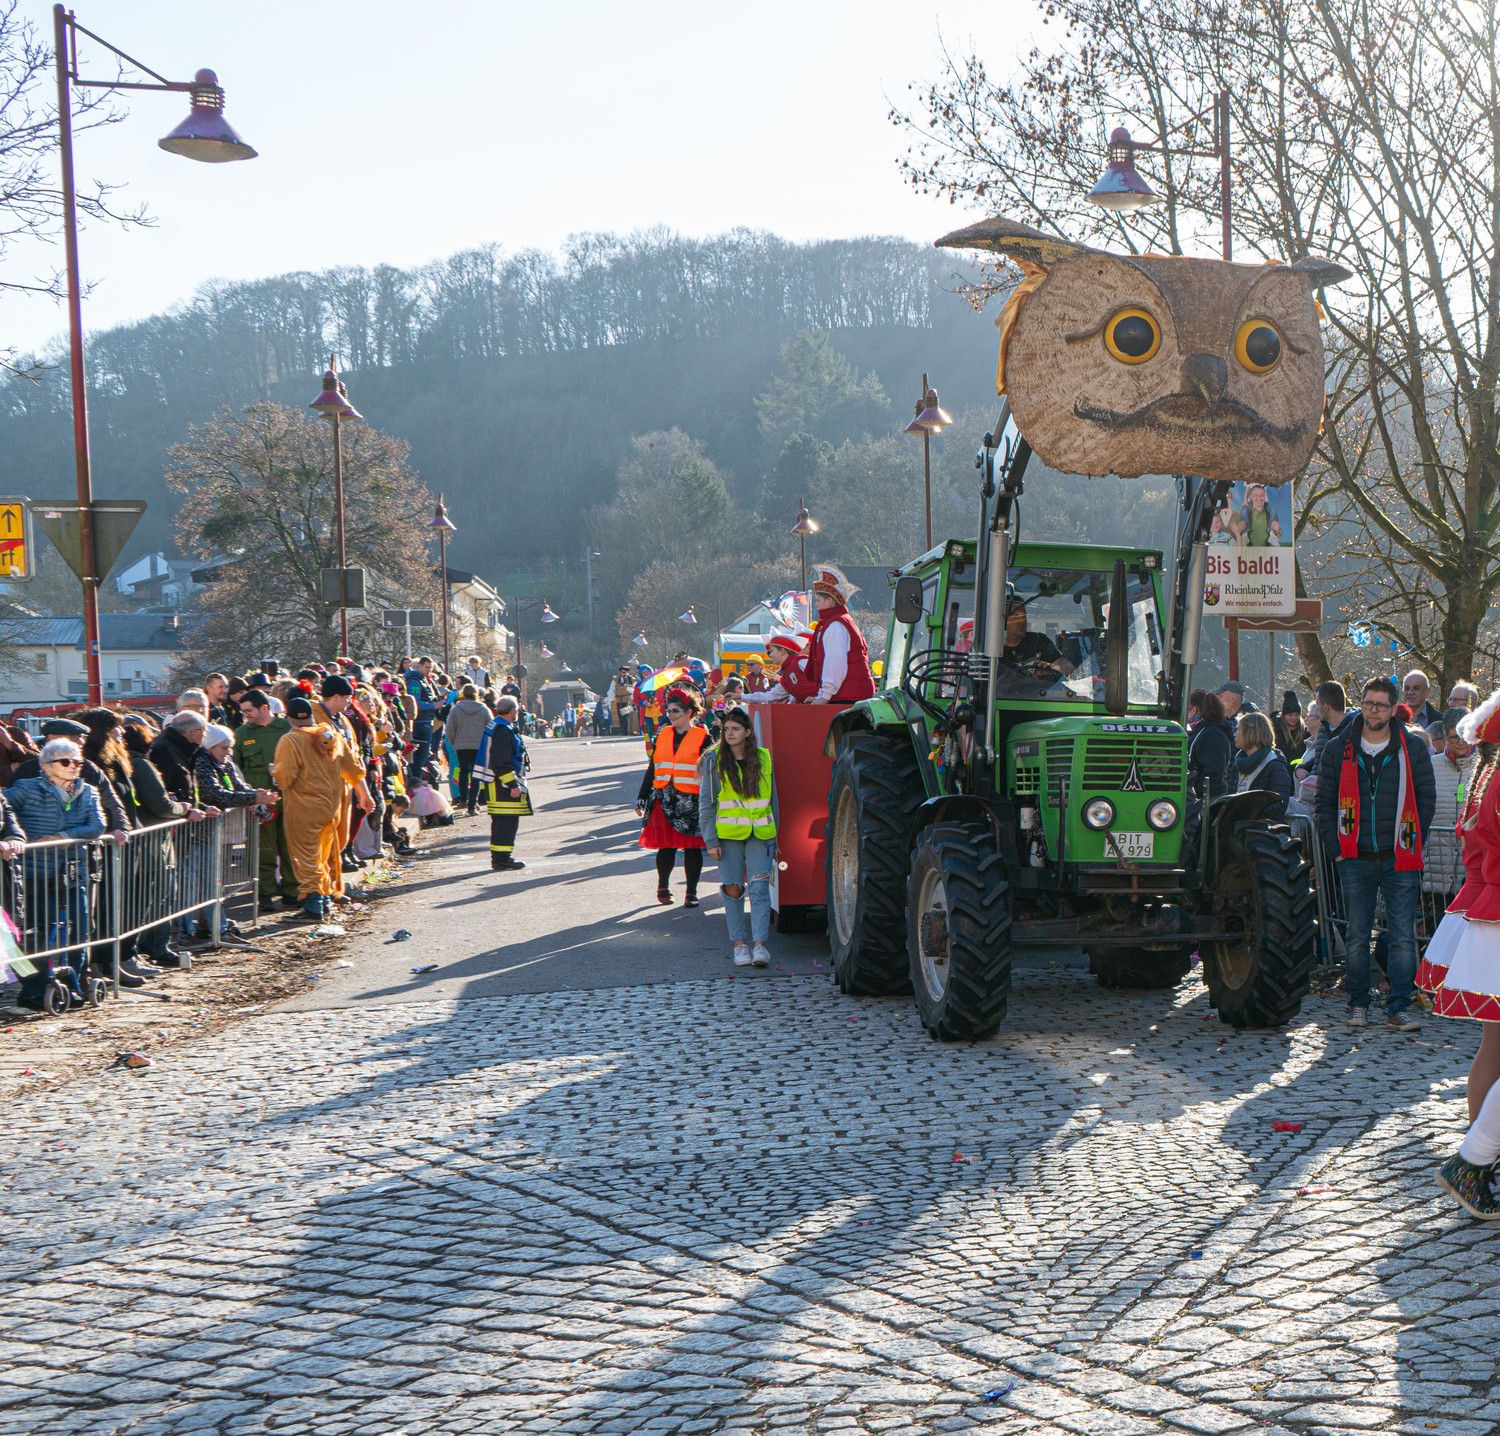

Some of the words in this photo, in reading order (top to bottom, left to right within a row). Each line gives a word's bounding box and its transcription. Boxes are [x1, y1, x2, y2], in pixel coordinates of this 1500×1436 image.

[1206, 555, 1231, 575] Bis
[1237, 555, 1280, 575] bald!
[1101, 723, 1169, 733] DEUTZ
[1118, 833, 1142, 845] BIT
[1128, 845, 1151, 857] 979
